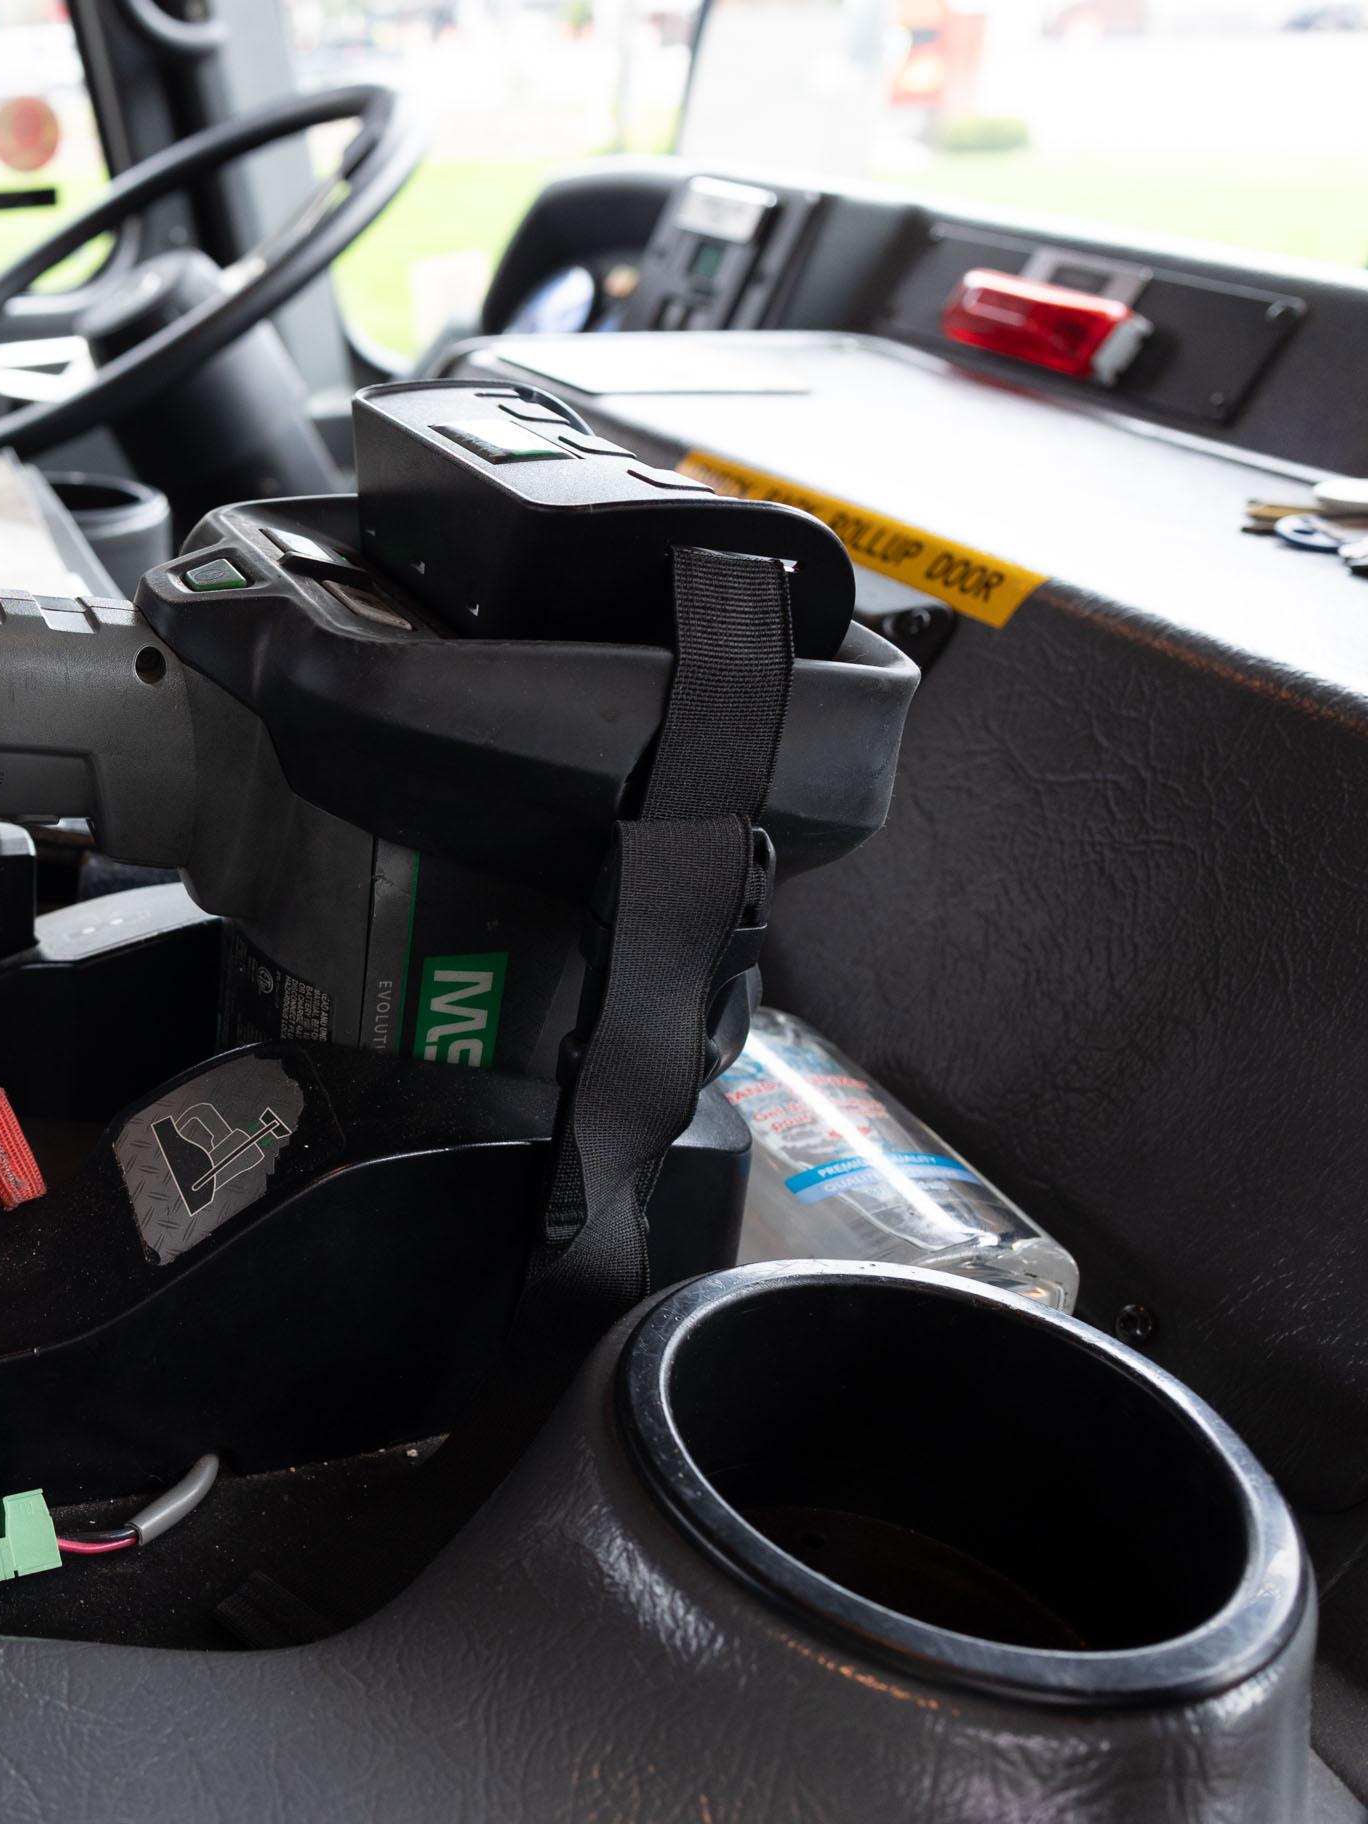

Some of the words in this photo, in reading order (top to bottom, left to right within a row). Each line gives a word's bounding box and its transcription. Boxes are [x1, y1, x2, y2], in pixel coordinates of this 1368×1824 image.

[924, 553, 1005, 602] DOOR
[282, 975, 292, 1019] HAZARDOUS
[289, 978, 298, 1024] DISCONNECT
[296, 993, 305, 1024] CHARGE
[304, 985, 313, 1017] BATTERY
[373, 981, 392, 1052] EVOLUTI
